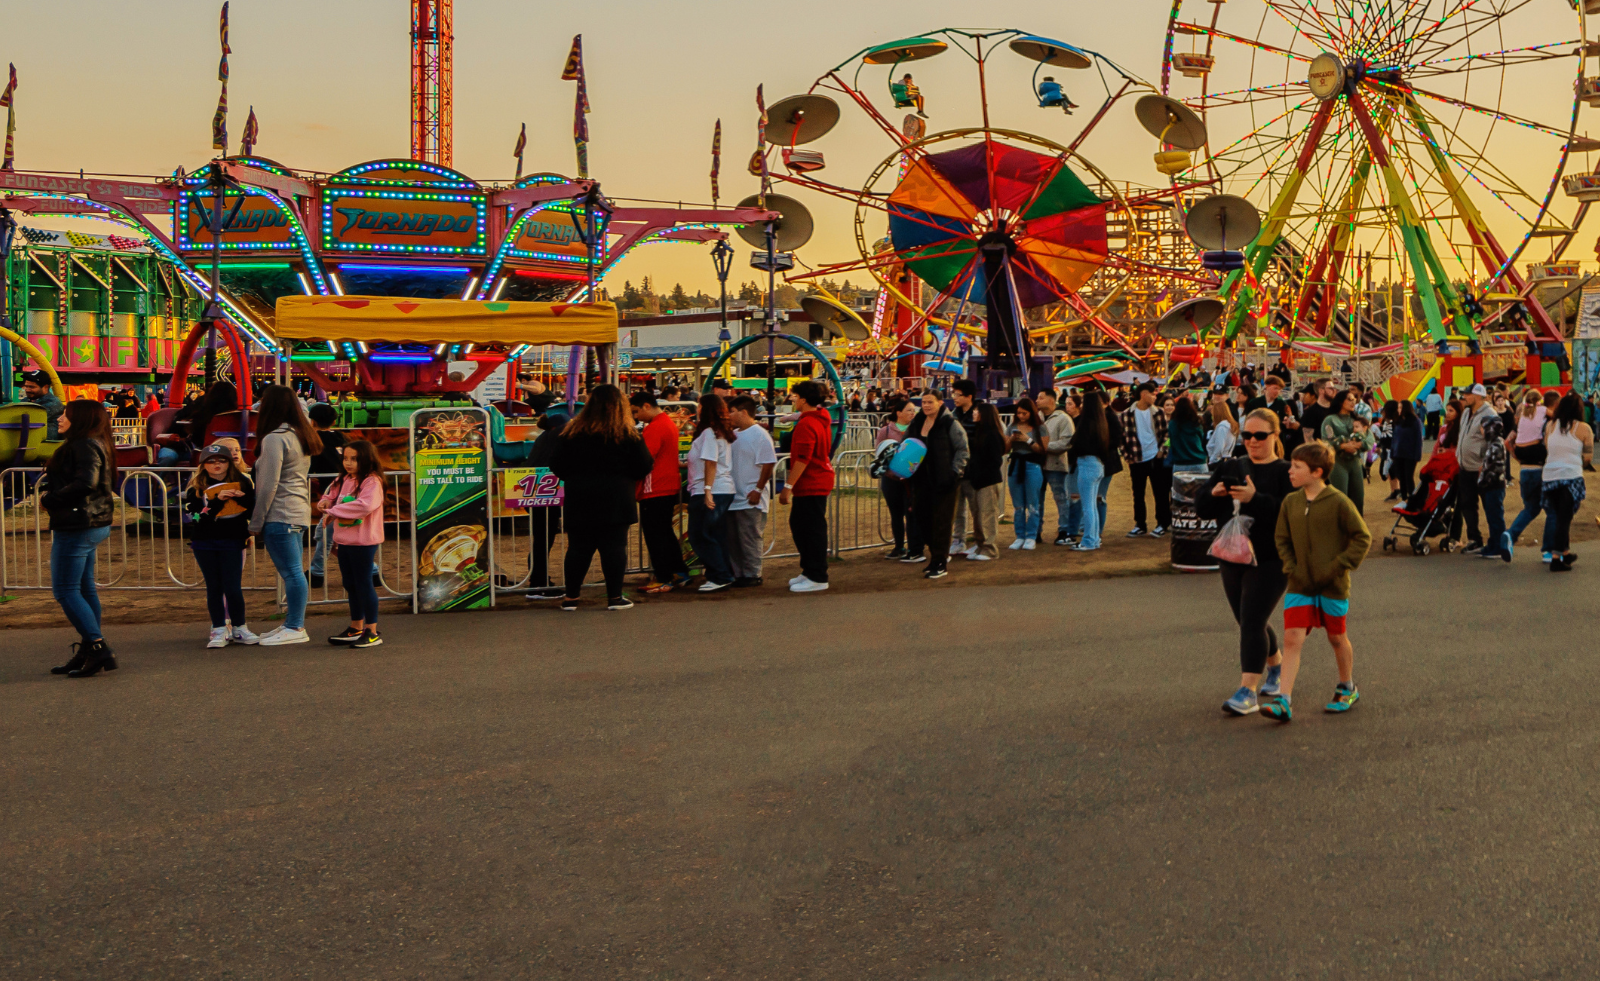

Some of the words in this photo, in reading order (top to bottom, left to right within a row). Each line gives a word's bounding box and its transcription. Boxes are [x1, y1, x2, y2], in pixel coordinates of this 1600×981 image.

[119, 184, 163, 198] RIDES
[191, 208, 288, 237] TRNADO
[336, 207, 476, 237] TORNADO
[516, 219, 590, 247] TORNAD
[419, 458, 454, 466] MINIMUM
[456, 457, 481, 465] HEIGHT
[419, 477, 435, 485] THIS
[518, 474, 560, 497] 12
[517, 498, 560, 507] TICKETS
[1172, 518, 1197, 529] TATE
